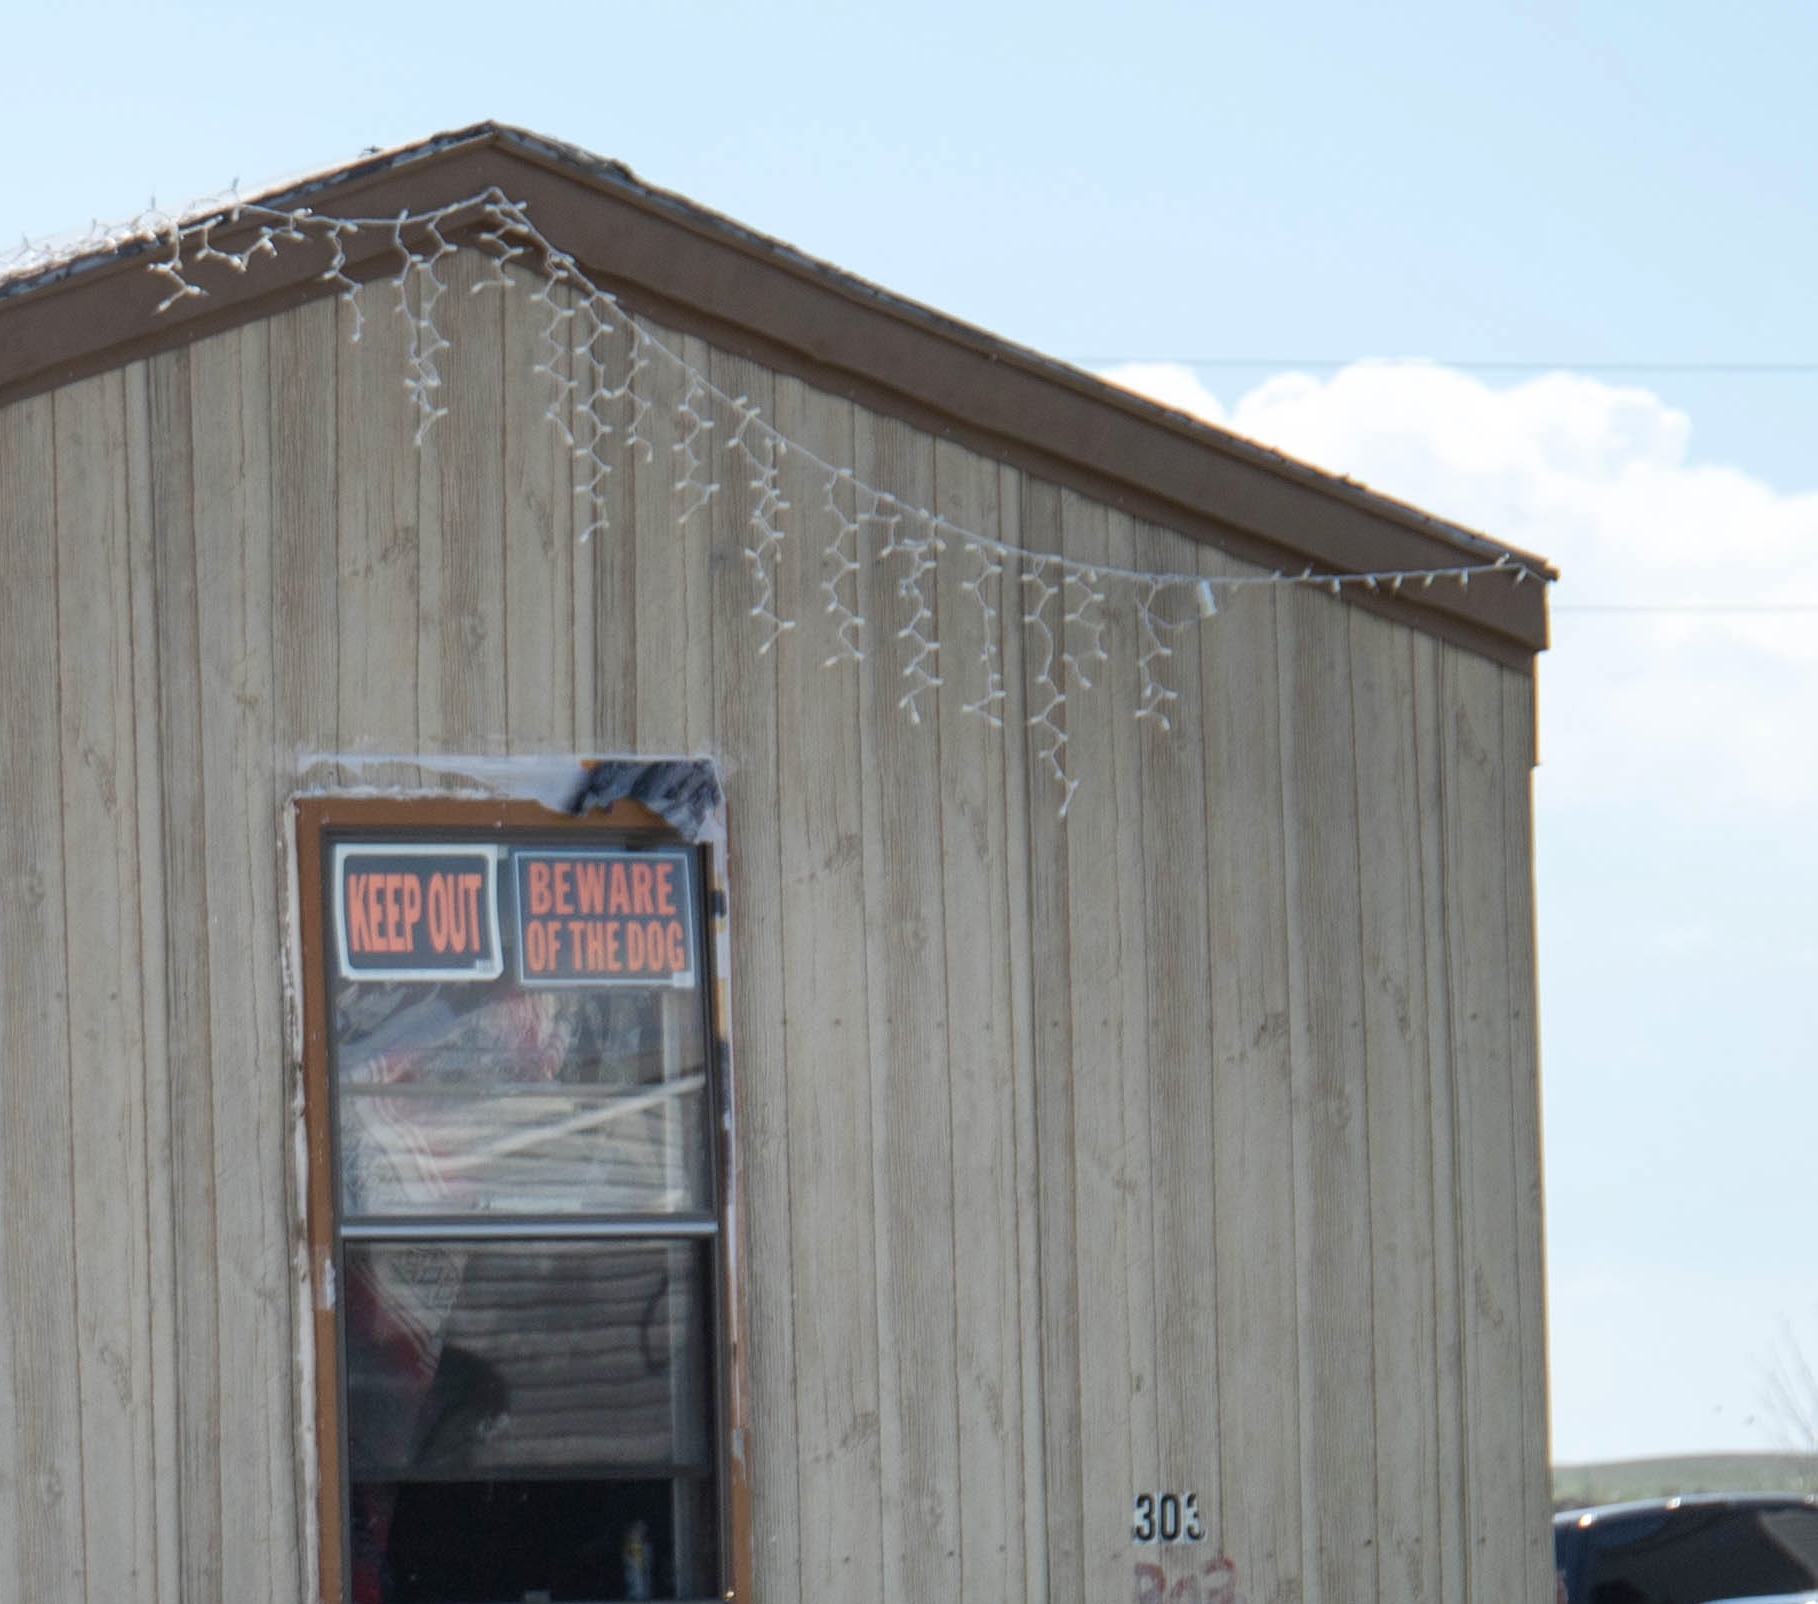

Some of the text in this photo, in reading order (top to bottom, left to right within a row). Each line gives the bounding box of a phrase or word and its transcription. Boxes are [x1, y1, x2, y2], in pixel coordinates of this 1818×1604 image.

[348, 872, 483, 955] KEEP OUT
[527, 862, 677, 916] BEWARE
[526, 920, 686, 973] OF THE DOG
